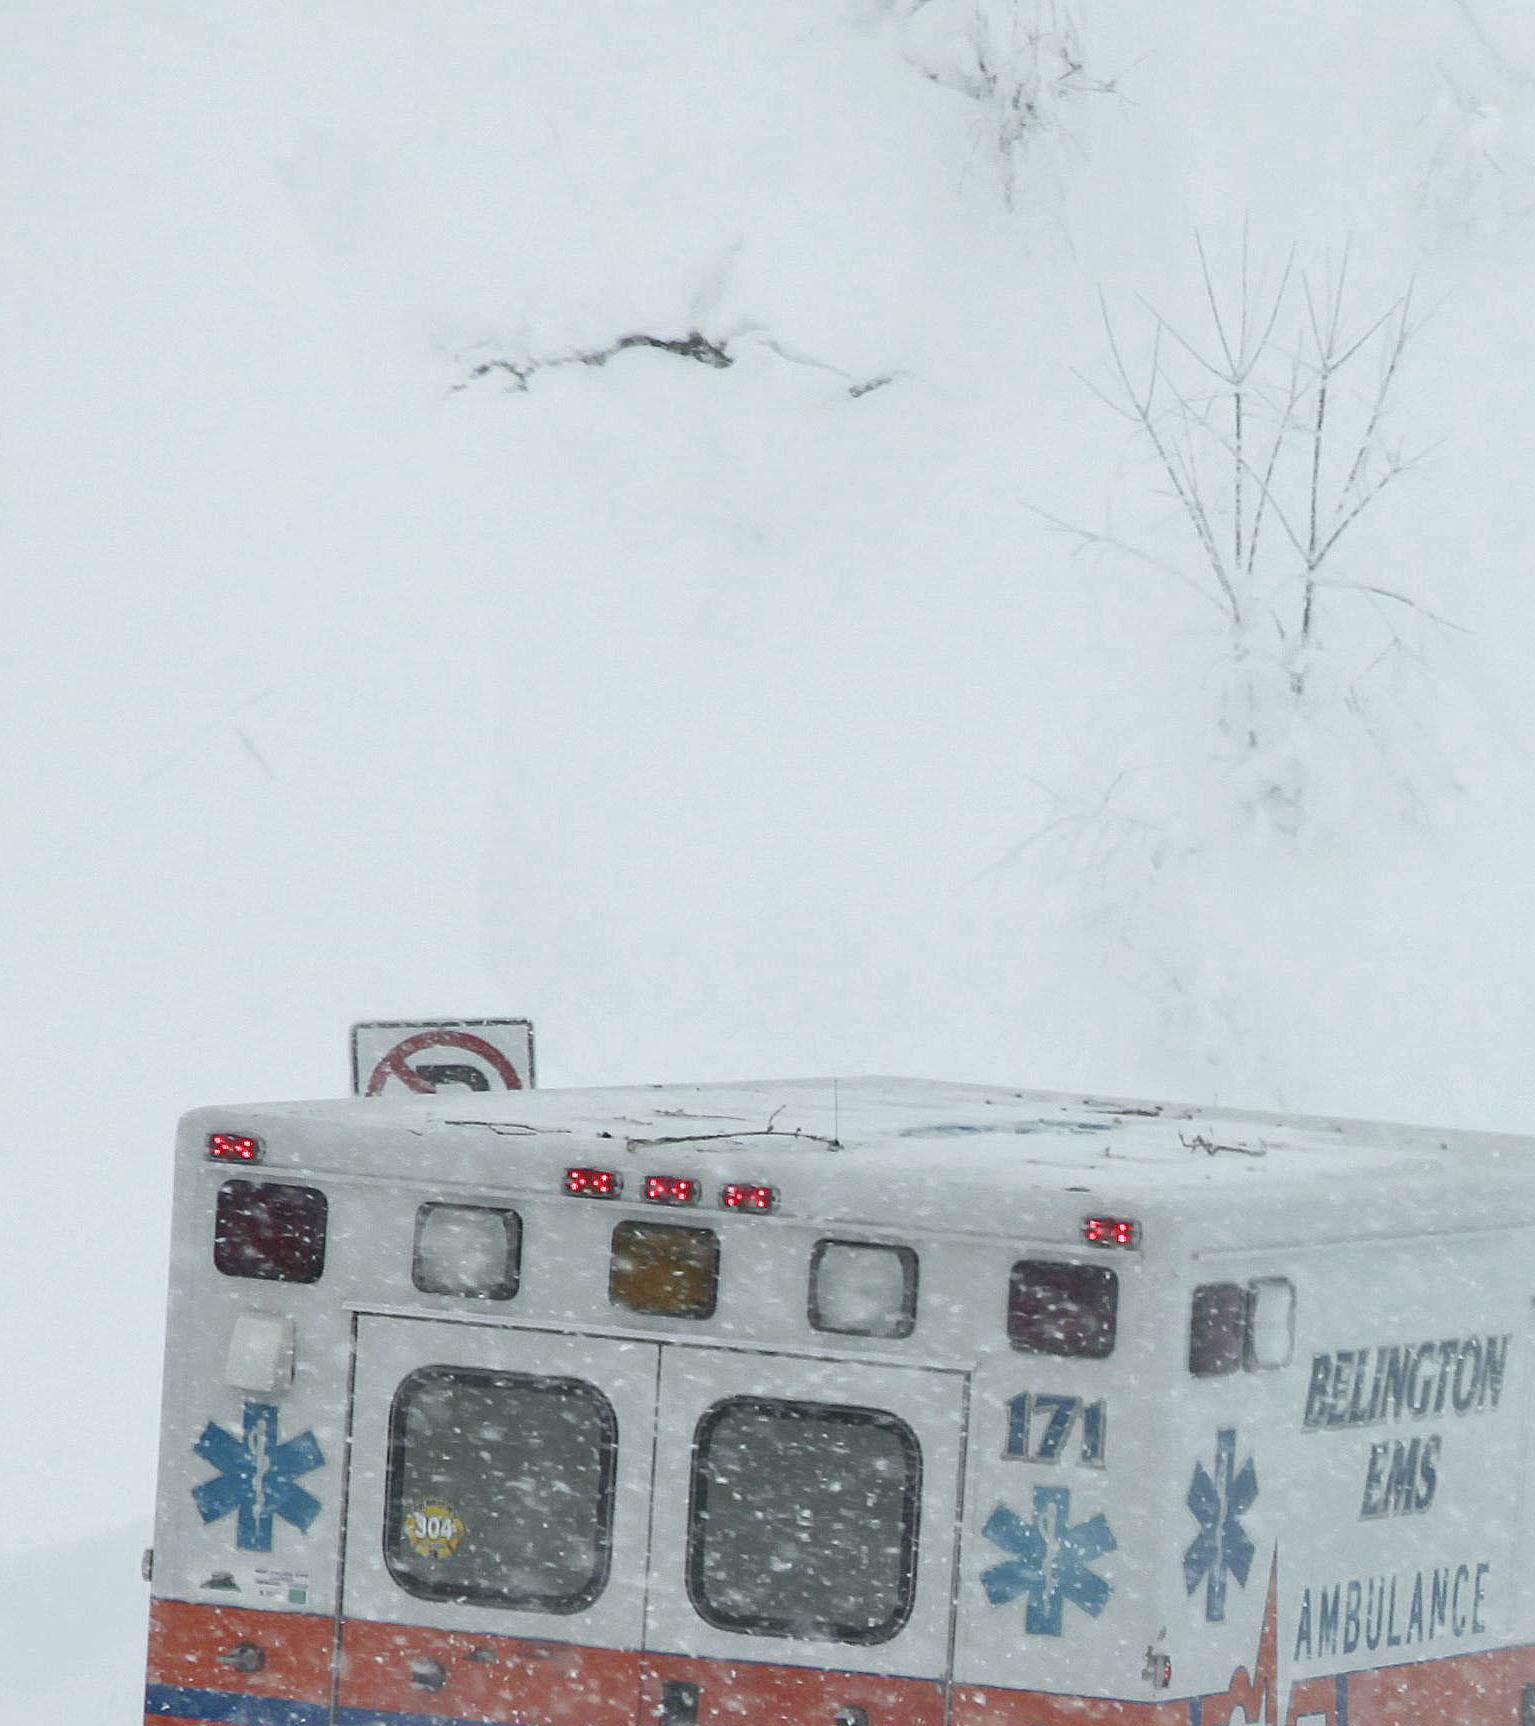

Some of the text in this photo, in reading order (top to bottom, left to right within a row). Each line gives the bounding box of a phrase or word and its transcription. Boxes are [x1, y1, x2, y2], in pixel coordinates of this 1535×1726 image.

[1300, 1334, 1512, 1433] BELINGTON
[1001, 1389, 1107, 1471] 171
[1357, 1434, 1443, 1522] EMS
[412, 1511, 453, 1540] 304
[1294, 1561, 1491, 1662] AMBULANCE
